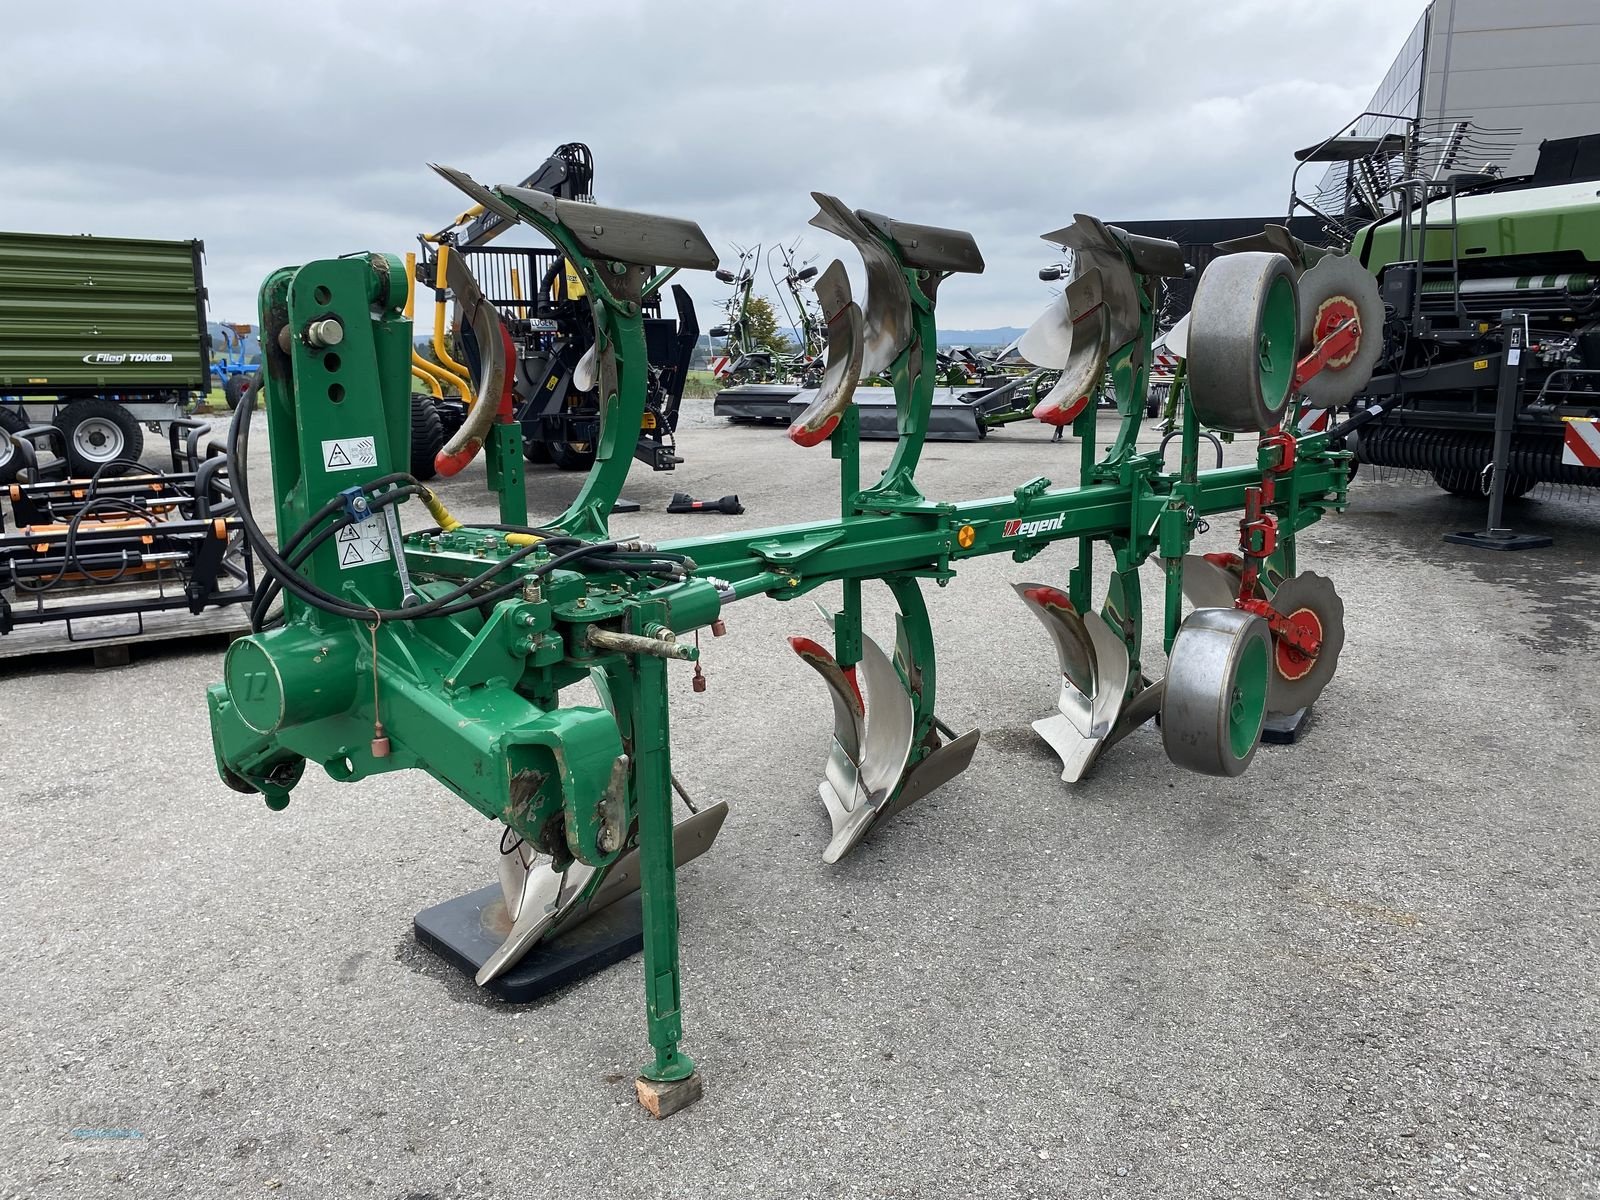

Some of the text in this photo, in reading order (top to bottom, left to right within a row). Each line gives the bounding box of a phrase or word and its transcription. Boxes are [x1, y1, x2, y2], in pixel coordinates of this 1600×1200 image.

[96, 353, 127, 364] Fliegl
[129, 353, 151, 362] TDK
[1002, 512, 1066, 538] Regent
